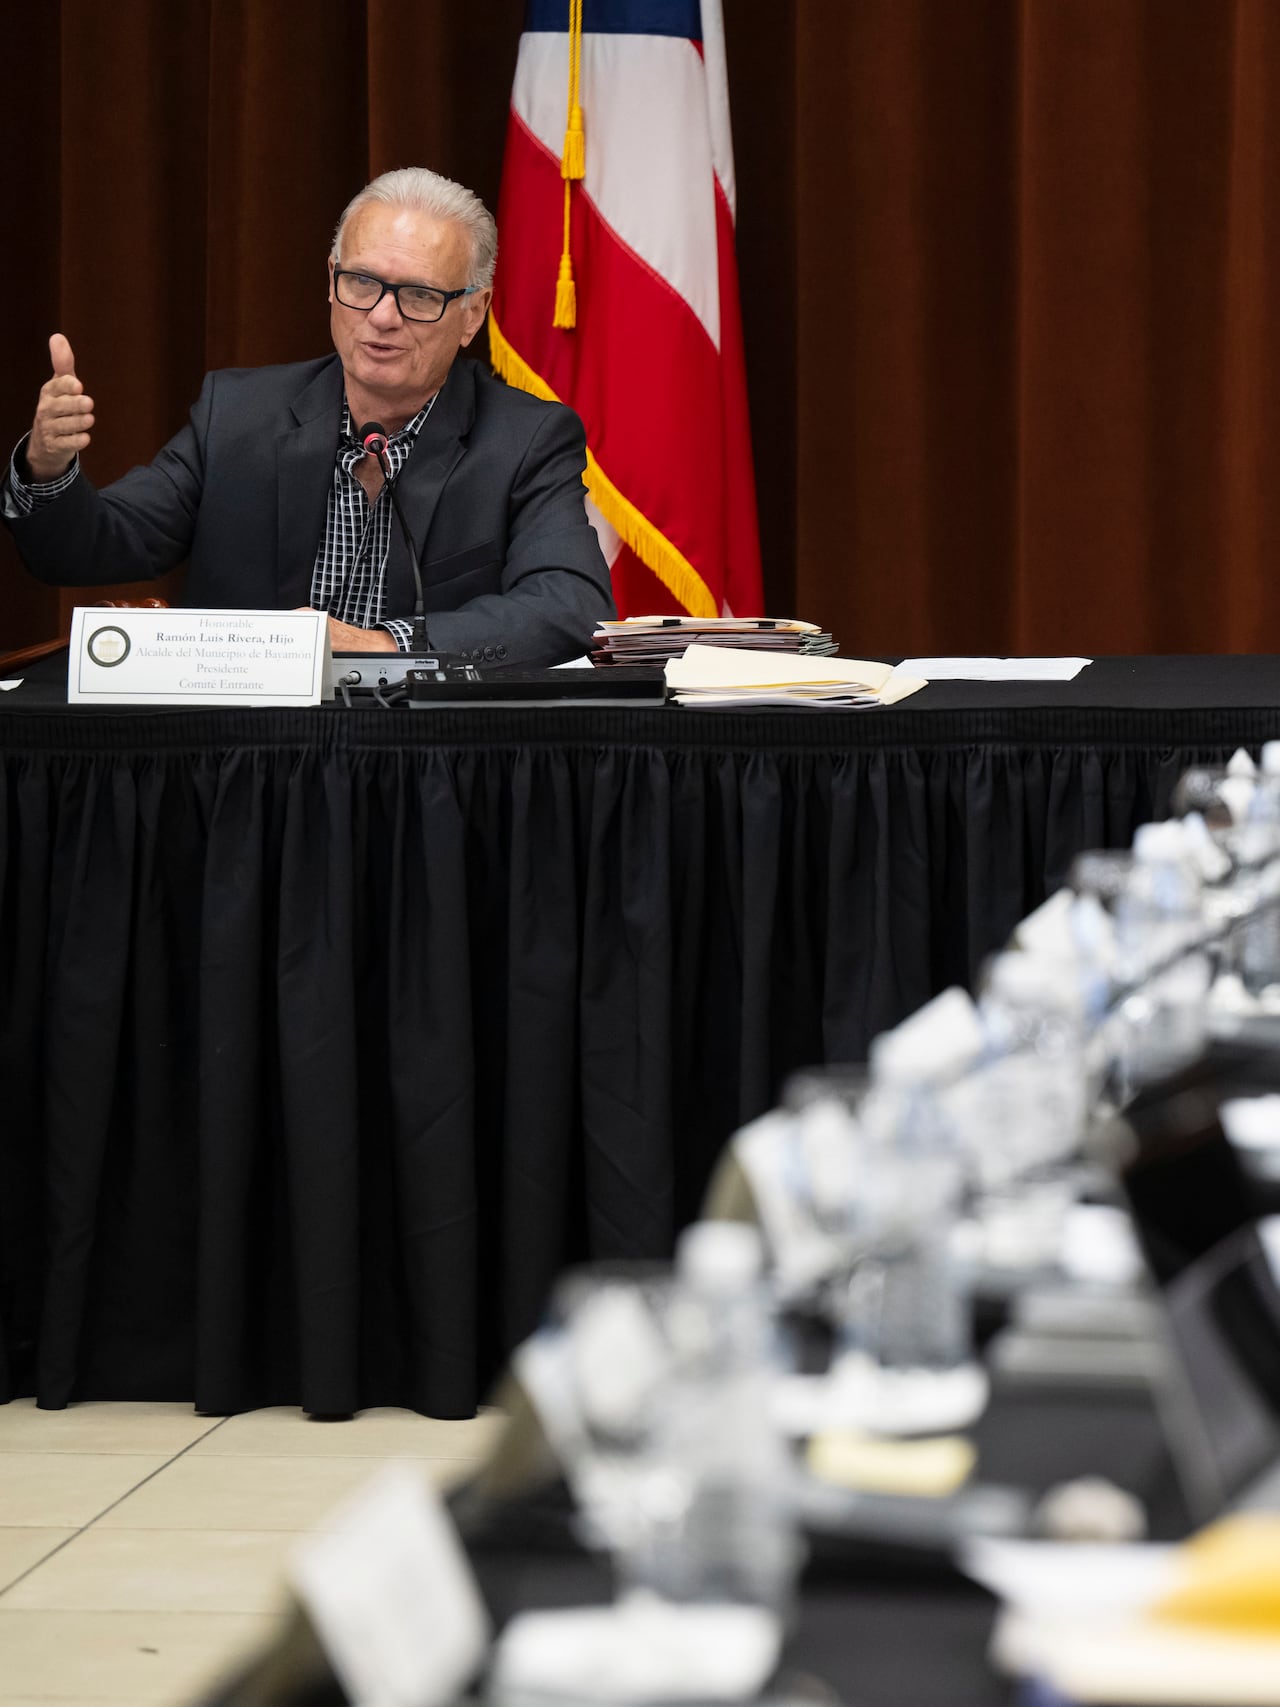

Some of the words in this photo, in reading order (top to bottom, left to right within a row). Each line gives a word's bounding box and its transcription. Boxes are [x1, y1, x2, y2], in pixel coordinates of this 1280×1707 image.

[200, 618, 254, 629] Honorable
[156, 632, 196, 642] Ramón
[199, 633, 224, 642] Luis
[228, 633, 265, 644] Rivera,
[269, 634, 294, 646] Hijo
[135, 647, 173, 657] Alcalde
[176, 648, 191, 657] del
[195, 648, 246, 661] Municipio
[249, 649, 262, 658] de
[196, 663, 249, 674] Presidente
[178, 678, 217, 689] Comité
[220, 679, 265, 690] Entrante
